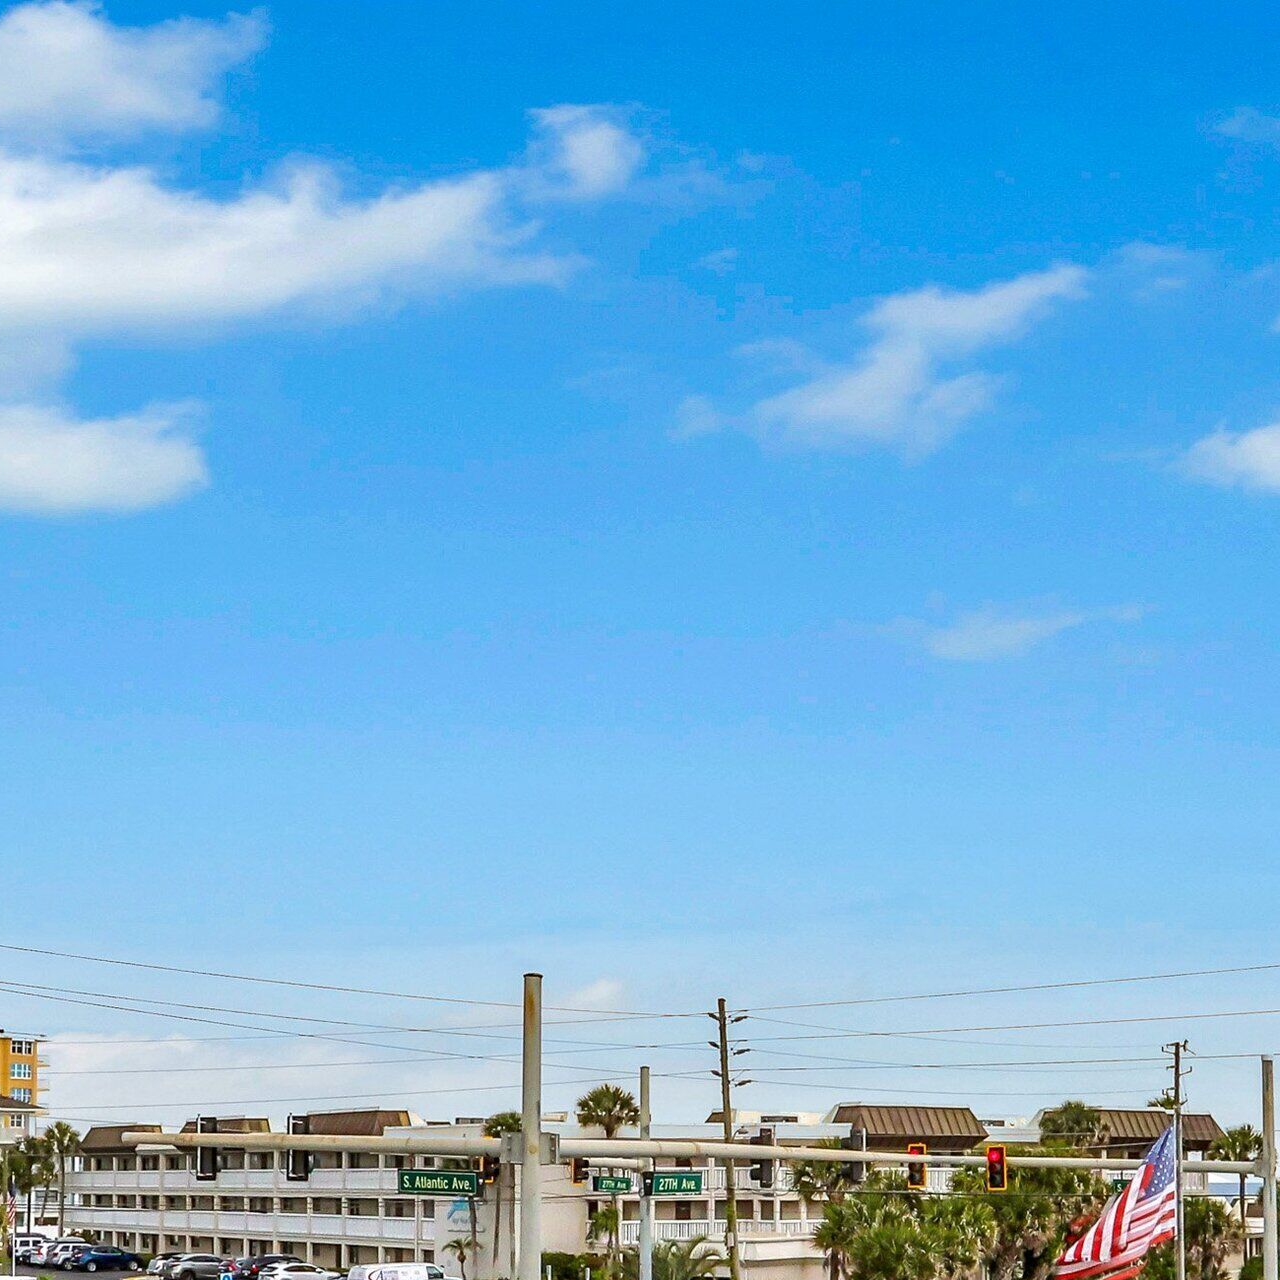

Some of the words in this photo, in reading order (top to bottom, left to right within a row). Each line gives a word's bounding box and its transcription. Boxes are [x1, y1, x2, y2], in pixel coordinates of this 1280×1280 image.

[403, 1175, 412, 1188] S.
[414, 1176, 449, 1189] Atlantic
[452, 1177, 472, 1190] Ave.
[659, 1179, 678, 1191] 27TH
